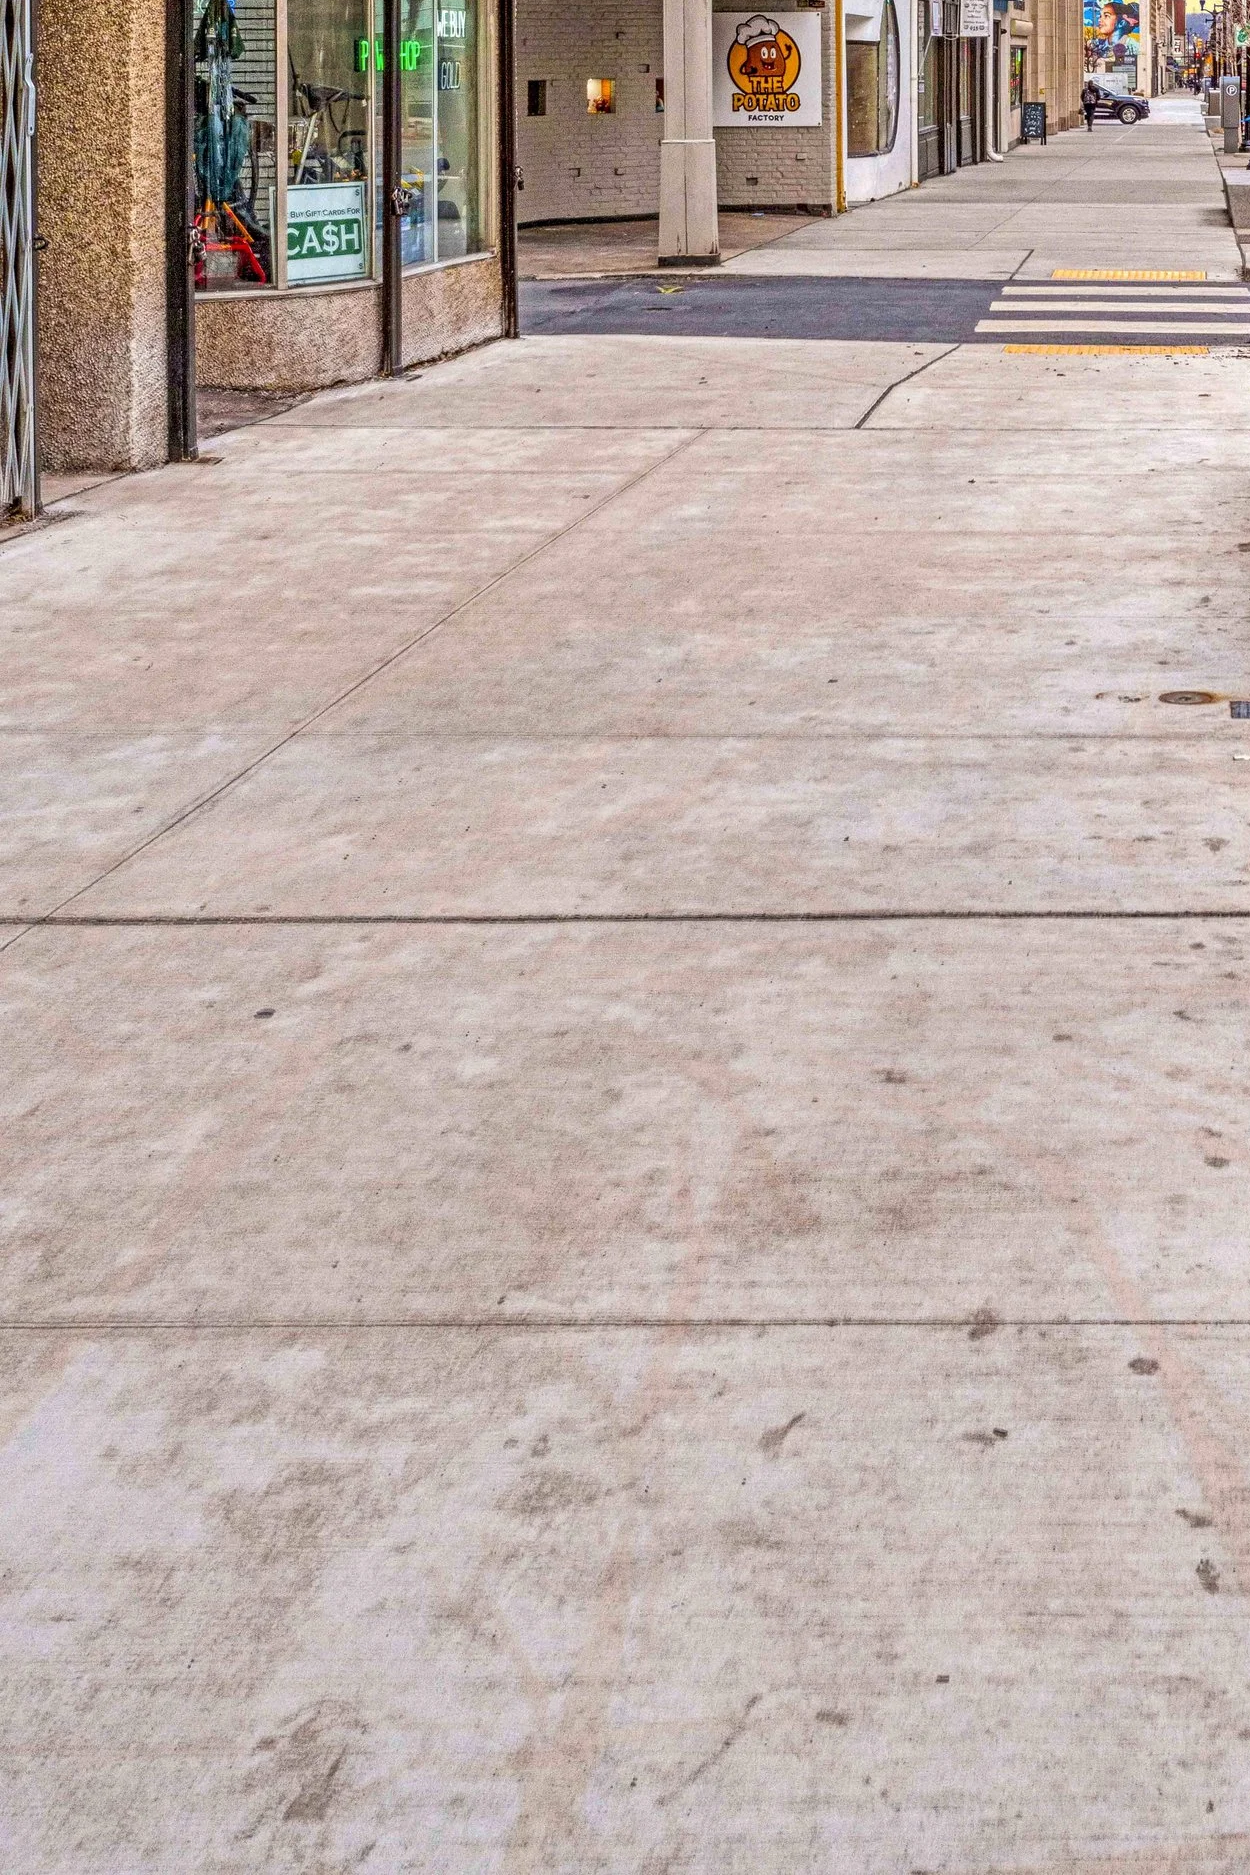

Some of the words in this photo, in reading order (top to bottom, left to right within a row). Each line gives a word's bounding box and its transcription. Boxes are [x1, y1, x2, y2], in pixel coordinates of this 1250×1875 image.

[437, 10, 448, 37] WE
[450, 11, 466, 37] BUY
[441, 62, 461, 89] GOLD
[749, 75, 784, 93] THE
[732, 93, 801, 112] POTATO
[748, 114, 784, 122] FACTORY
